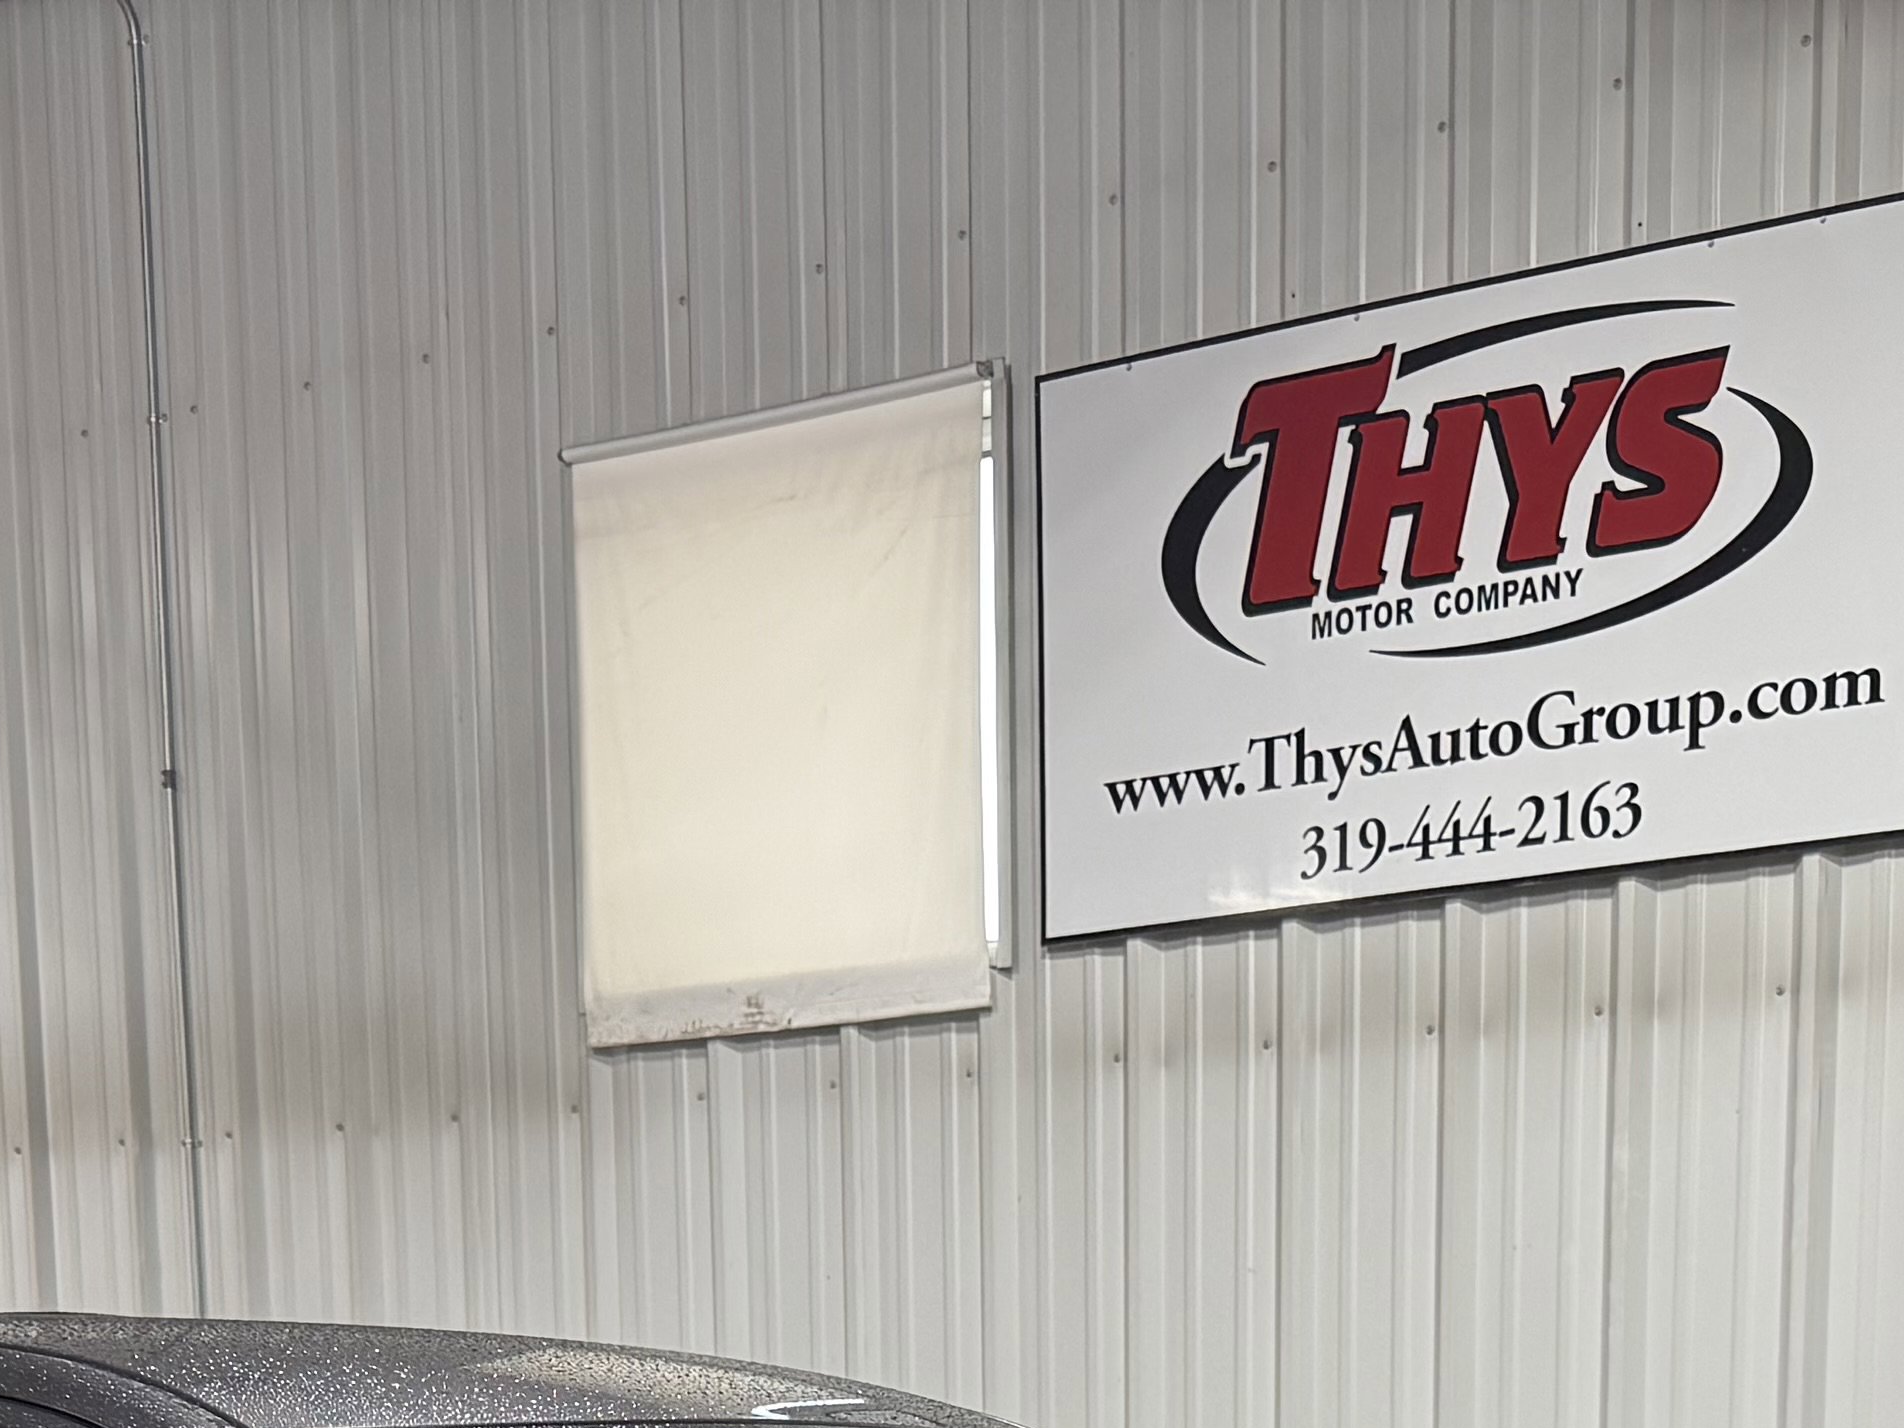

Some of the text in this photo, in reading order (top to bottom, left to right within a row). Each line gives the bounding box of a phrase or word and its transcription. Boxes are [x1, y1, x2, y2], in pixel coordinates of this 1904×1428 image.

[1228, 343, 1732, 618] THYS
[1311, 567, 1584, 641] MOTOR COMPANY
[1103, 667, 1886, 814] www.ThysAutoGroup.com
[1300, 780, 1643, 880] 319-444-2163
